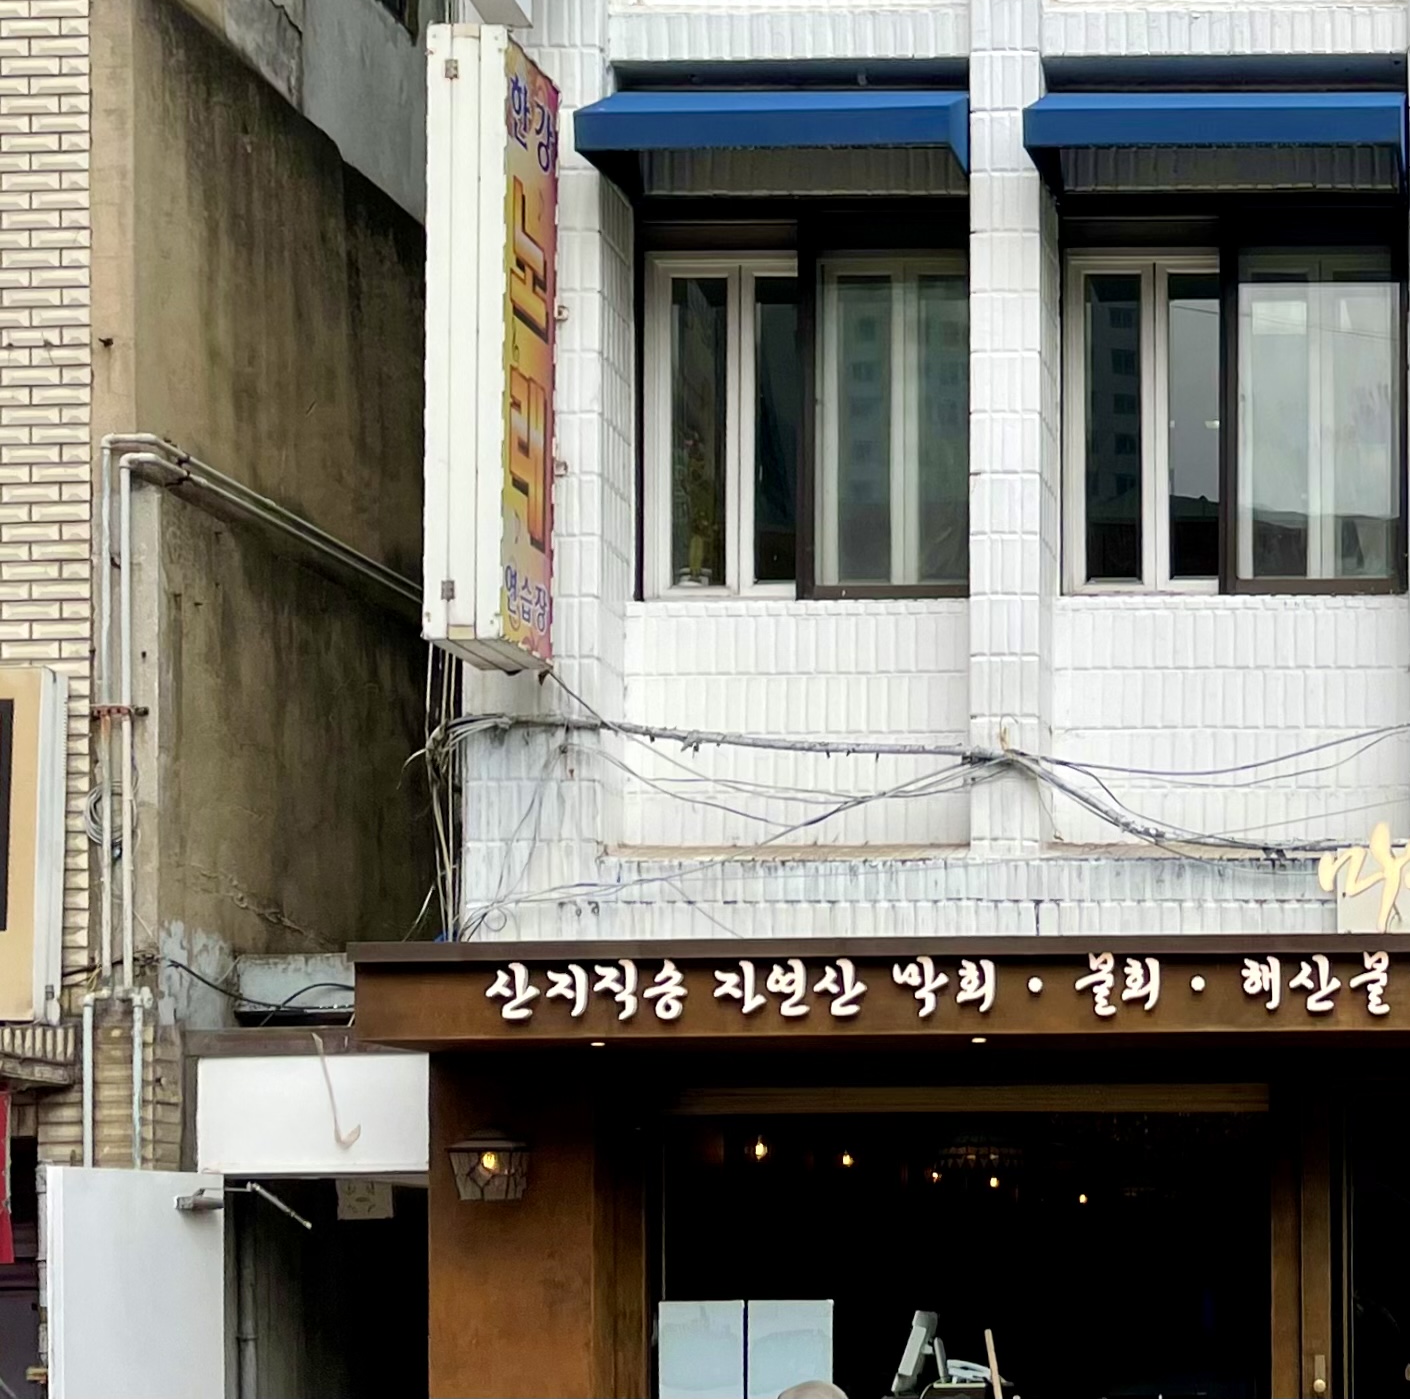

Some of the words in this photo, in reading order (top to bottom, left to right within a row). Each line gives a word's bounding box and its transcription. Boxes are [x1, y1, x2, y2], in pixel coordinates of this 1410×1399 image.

[510, 74, 556, 174] 한강
[509, 175, 549, 553] 노래
[504, 564, 549, 636] 연습장
[485, 958, 689, 1021] 산지직송
[713, 957, 868, 1018] 자연산
[892, 955, 997, 1018] 막회
[1075, 950, 1161, 1016] 물회
[1241, 950, 1391, 1015] 해산물
